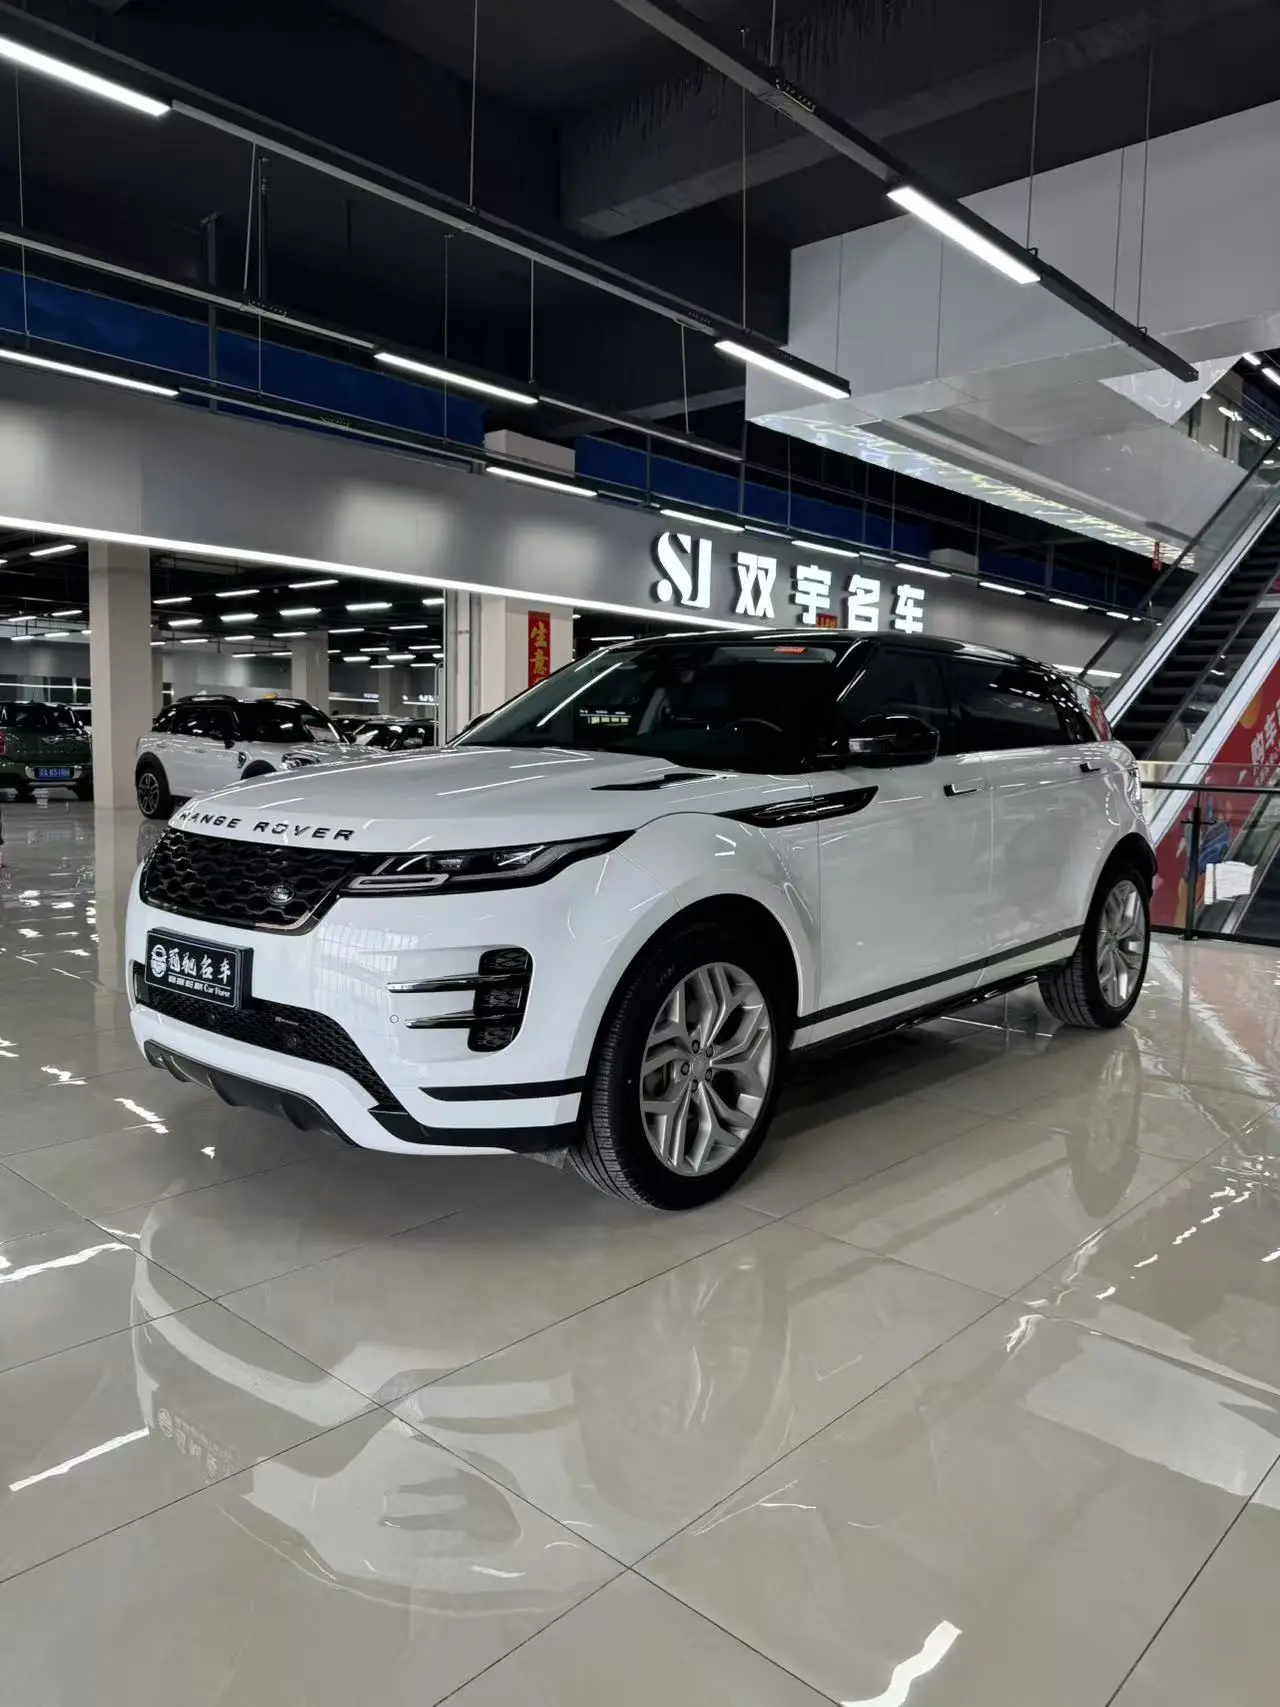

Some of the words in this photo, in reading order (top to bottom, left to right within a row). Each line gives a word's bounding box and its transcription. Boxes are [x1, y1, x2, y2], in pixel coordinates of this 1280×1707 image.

[735, 551, 925, 633] 双宇名车
[529, 620, 549, 685] 生意
[179, 812, 242, 829] RANGE
[253, 821, 356, 841] ROVER
